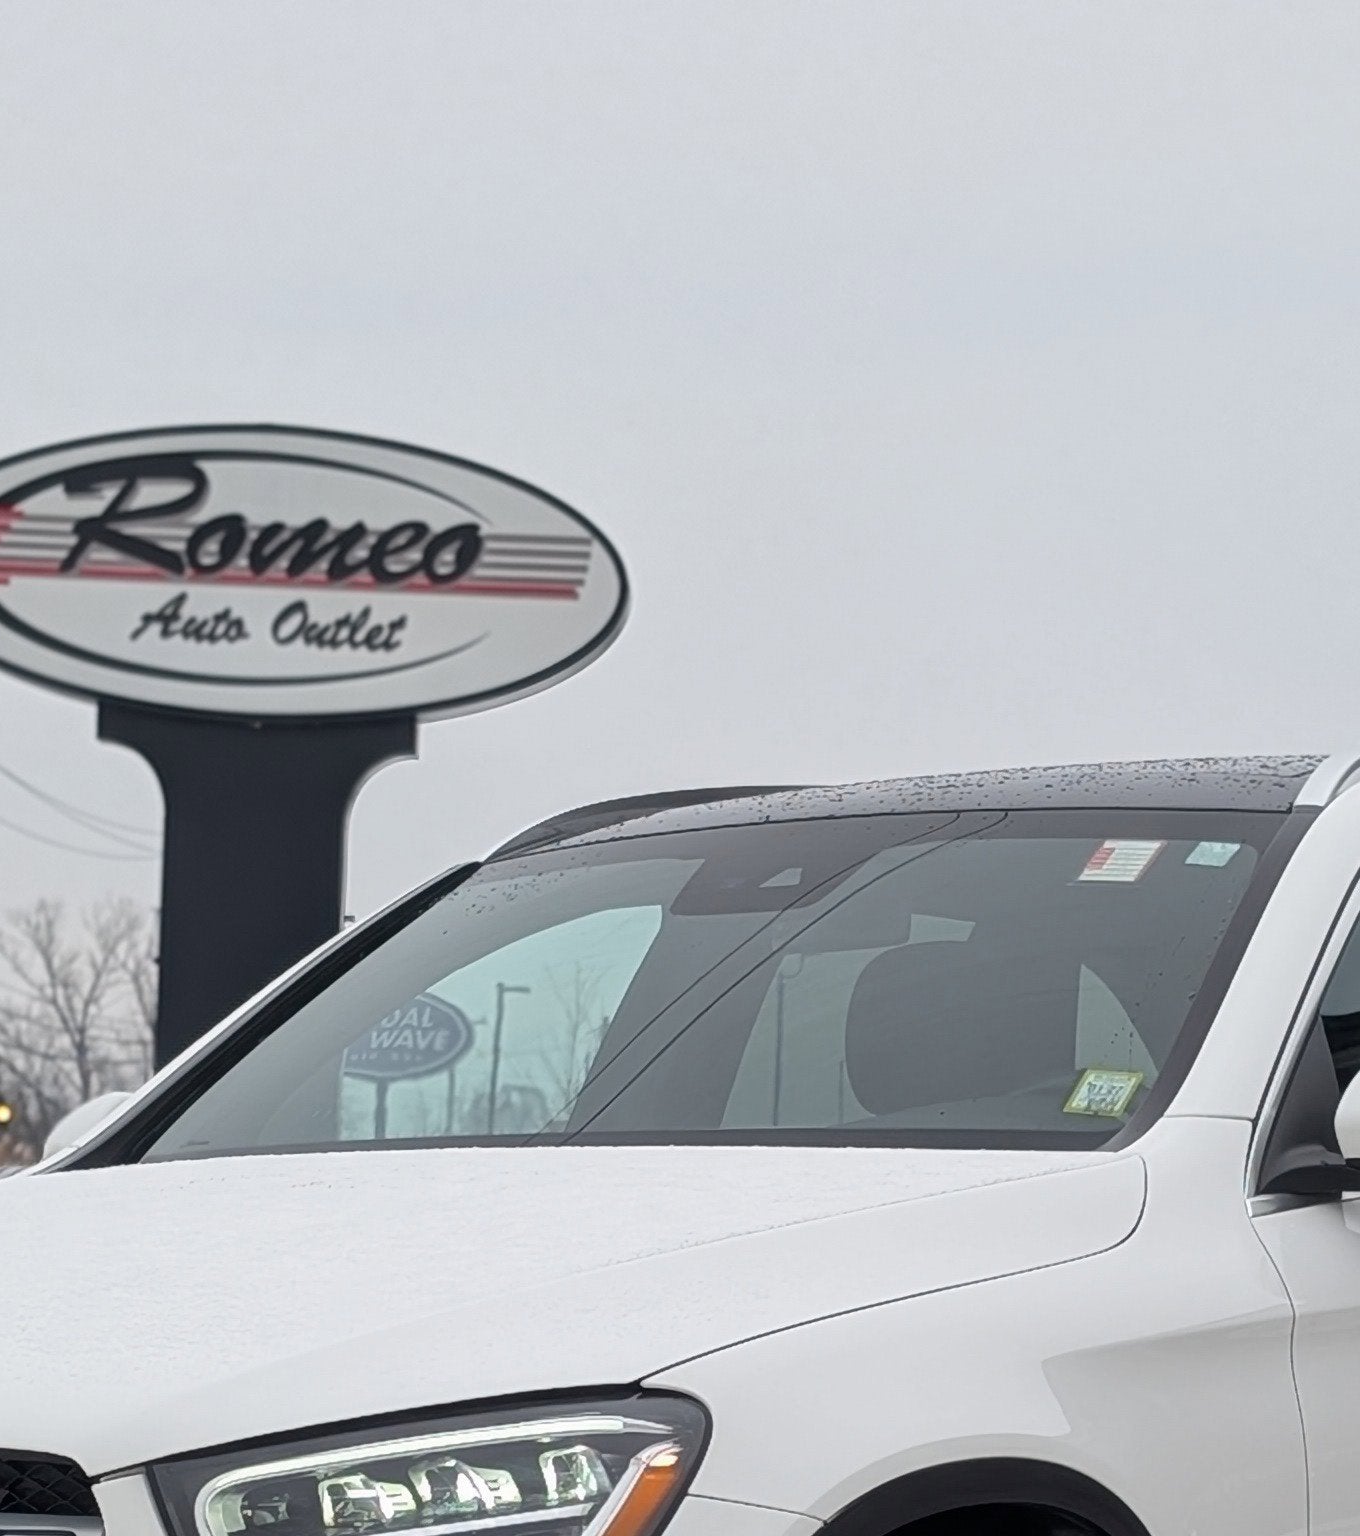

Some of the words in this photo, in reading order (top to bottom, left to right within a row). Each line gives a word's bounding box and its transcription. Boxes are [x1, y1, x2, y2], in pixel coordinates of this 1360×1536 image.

[59, 460, 483, 583] Romeo
[129, 592, 249, 643] Auto
[269, 599, 408, 651] Outlet
